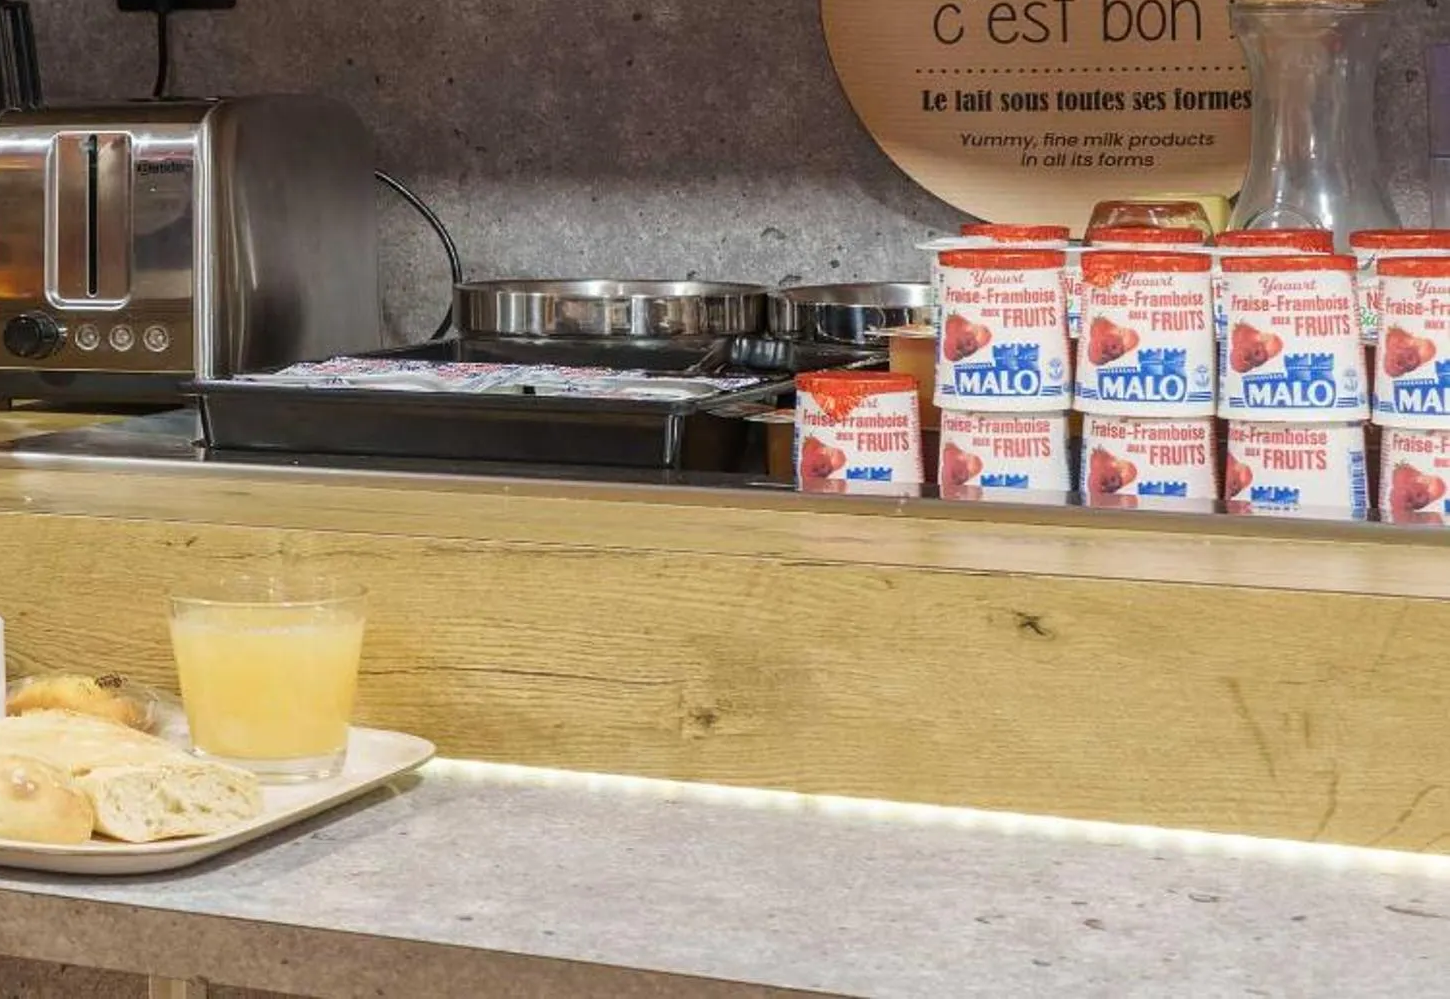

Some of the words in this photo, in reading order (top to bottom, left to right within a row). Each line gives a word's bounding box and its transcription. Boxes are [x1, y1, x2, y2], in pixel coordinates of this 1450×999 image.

[921, 89, 948, 112] Le
[955, 89, 993, 113] lait
[1000, 91, 1050, 113] sous
[1056, 89, 1126, 112] toutes
[1132, 90, 1167, 112] ses
[1173, 87, 1253, 111] formes
[960, 132, 1038, 151] Yummy,
[1043, 131, 1078, 148] fine
[1082, 131, 1123, 148] milk
[1128, 131, 1216, 151] products
[1021, 152, 1038, 168] in
[1043, 151, 1066, 168] all
[1071, 152, 1094, 168] its
[1097, 151, 1155, 168] forms
[970, 271, 1026, 288] Yaourt
[1119, 272, 1173, 289] Yaourt
[1258, 276, 1317, 296] Yaourt
[947, 286, 1057, 305] Fraise-Framboise
[1090, 288, 1204, 308] Fraise-Framboise
[1231, 294, 1350, 313] Fraise-Framboise
[1002, 307, 1057, 329] FRUITS
[1150, 310, 1206, 332] FRUITS
[1295, 315, 1351, 337] FRUITS
[959, 369, 1039, 396] MALO
[1101, 374, 1186, 401] MALO
[1248, 379, 1334, 407] MALO
[1091, 419, 1206, 441] Fraise-Framboise
[856, 432, 910, 453] FRUITS
[993, 437, 1051, 458] FRUITS
[1149, 443, 1206, 466] FRUITS
[1262, 448, 1328, 471] FRUITS
